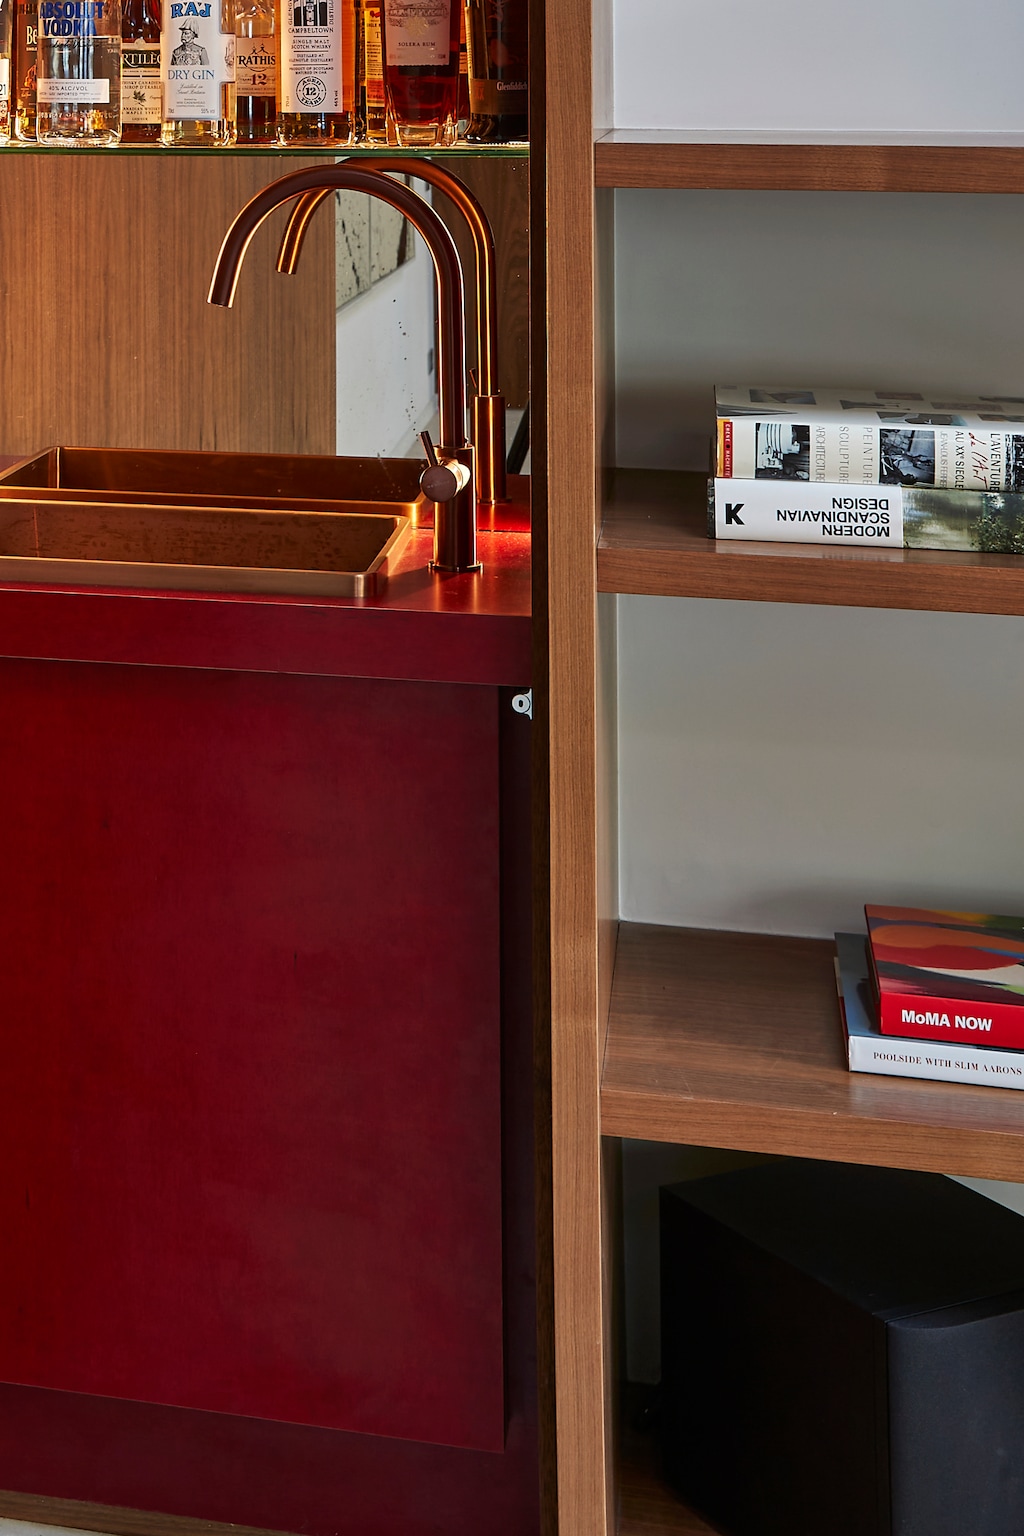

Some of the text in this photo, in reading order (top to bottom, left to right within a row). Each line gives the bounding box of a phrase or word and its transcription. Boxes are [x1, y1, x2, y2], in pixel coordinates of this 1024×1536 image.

[40, 1, 104, 18] ABSOLUT
[43, 20, 97, 36] VODKA
[236, 55, 275, 67] RATHIS
[168, 69, 215, 80] DRY GIN
[251, 74, 267, 85] 12
[305, 87, 316, 95] 12
[955, 431, 964, 443] AU
[969, 432, 987, 446] de
[816, 426, 825, 482] ARCHITECTURE
[839, 426, 849, 483] SCULPTURE
[862, 427, 873, 484] PEINTURE
[990, 433, 1001, 492] L'AVENTURE
[832, 497, 889, 510] DESIGN
[725, 503, 745, 525] K
[777, 510, 890, 524] SCANDINAVIAN
[822, 524, 890, 537] MODERN
[901, 1009, 992, 1031] MoMA NOW
[873, 1051, 1022, 1075] POOLSIDE WITH SLIM AARONS
